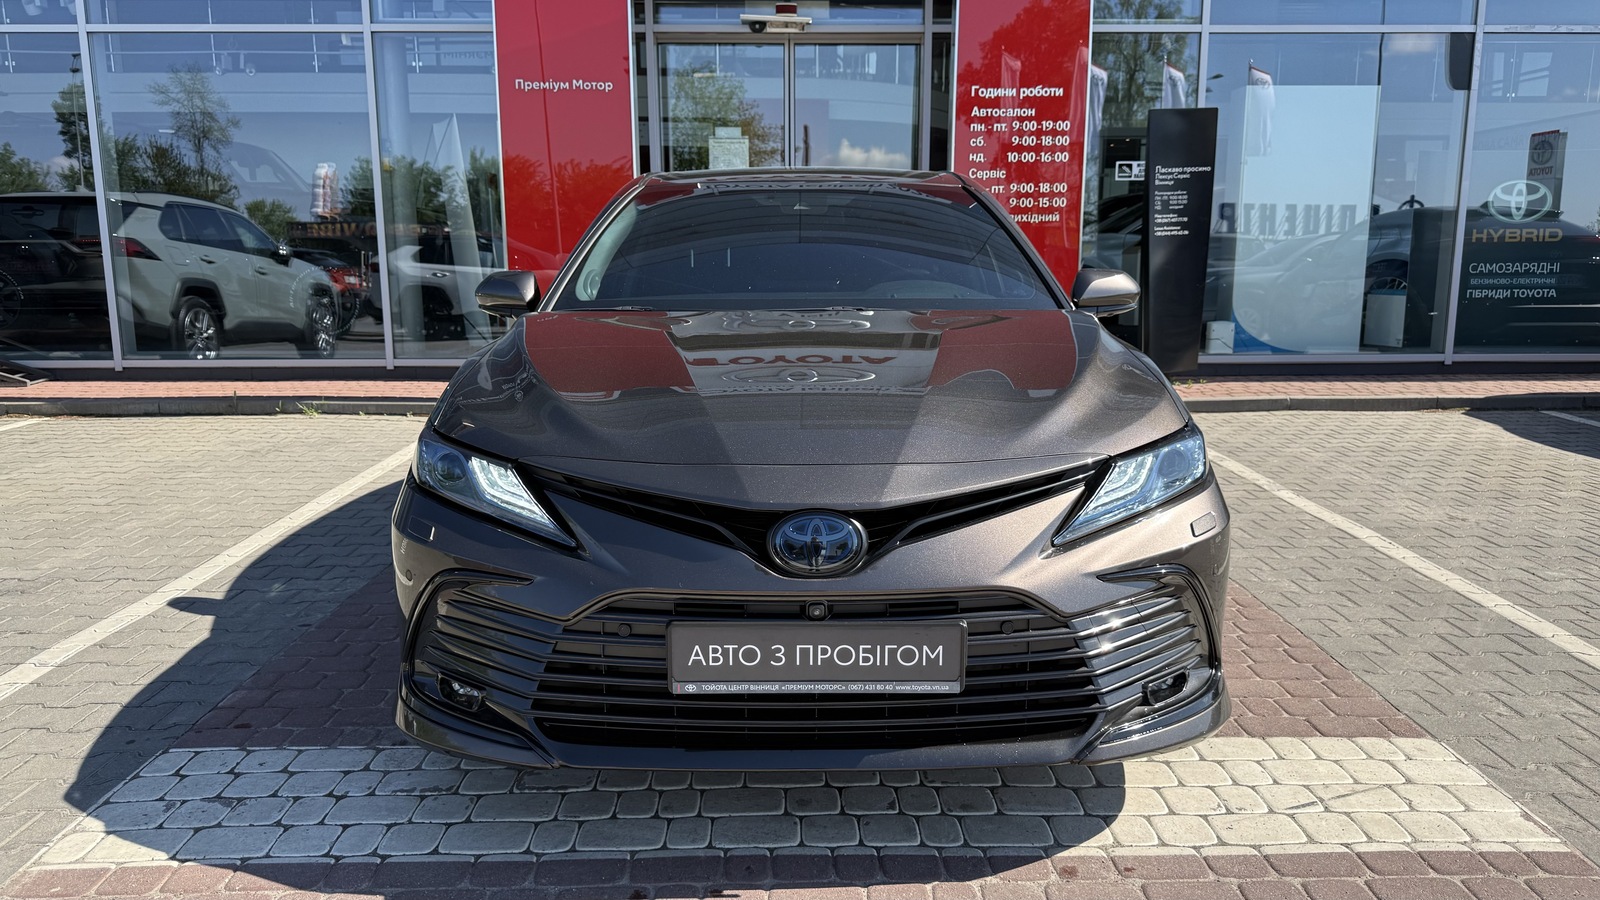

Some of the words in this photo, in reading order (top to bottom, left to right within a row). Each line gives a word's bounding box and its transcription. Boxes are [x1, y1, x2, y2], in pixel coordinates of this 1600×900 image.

[515, 79, 570, 92] Преміум
[572, 79, 613, 92] Мотор
[971, 86, 1016, 99] Години
[1020, 85, 1064, 99] роботи
[971, 106, 1036, 117] Автосалон
[1012, 121, 1071, 132] 9:00-19:00
[970, 136, 987, 147] сб.
[1012, 136, 1070, 146] 9:00-18:00
[969, 153, 987, 163] нд.
[1007, 152, 1069, 163] 10:00-16:00
[969, 168, 1006, 180] Сервіс
[1010, 183, 1068, 193] 9:00-18:00
[1009, 197, 1067, 208] 9:00-15:00
[1471, 228, 1563, 242] HYBRID
[1468, 262, 1560, 274] САМОЗАРЯДНІ
[1466, 289, 1511, 299] ГІБРИДИ
[1512, 288, 1557, 298] TOYOTA
[687, 644, 761, 666] АВТО
[769, 644, 786, 666] З
[796, 644, 943, 666] ПРОБІГОМ
[701, 683, 727, 692] ТОЙОТА
[728, 684, 749, 692] ЦЕНТР
[750, 684, 779, 692] ВІННИЦЯ
[895, 684, 950, 692] www.toyota.vn.ua
